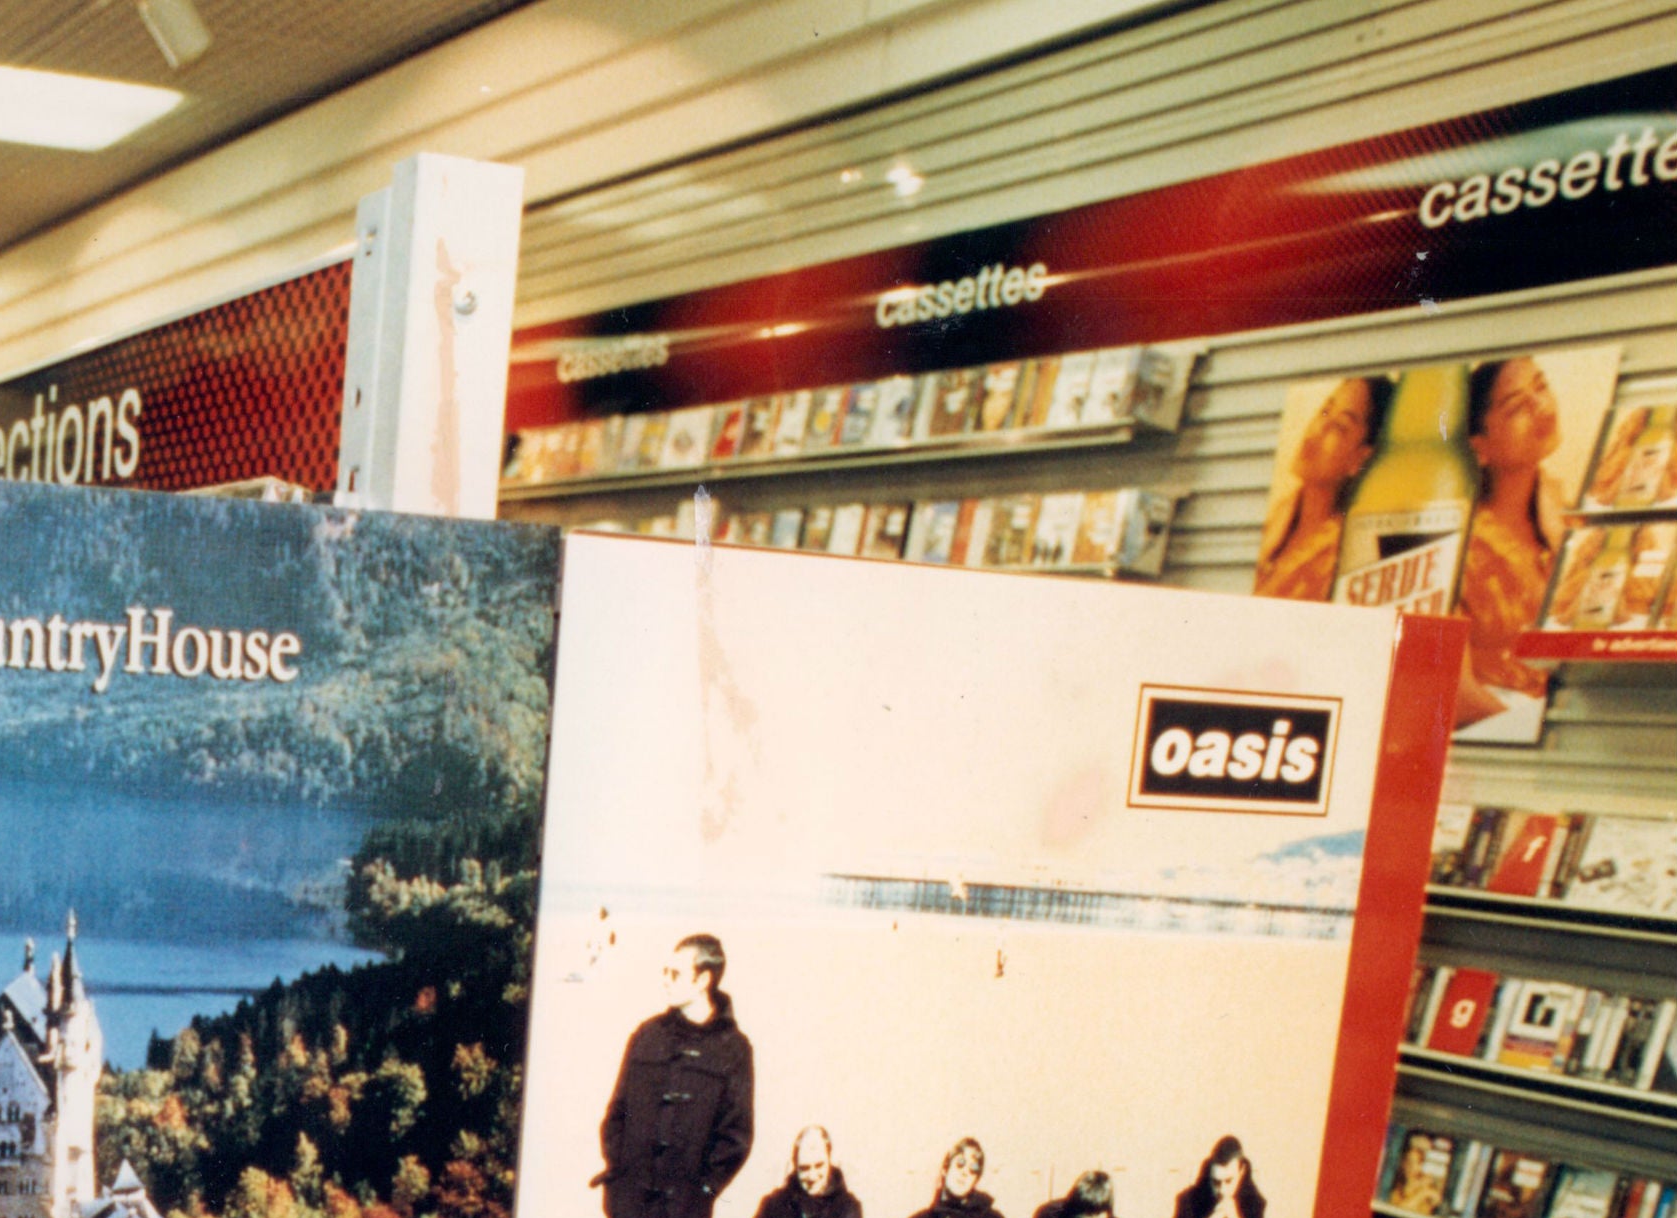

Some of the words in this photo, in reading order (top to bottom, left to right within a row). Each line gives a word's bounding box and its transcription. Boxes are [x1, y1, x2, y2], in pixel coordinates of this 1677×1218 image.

[876, 262, 1048, 328] cassettes
[1150, 718, 1319, 783] oasis
[1449, 998, 1477, 1029] g
